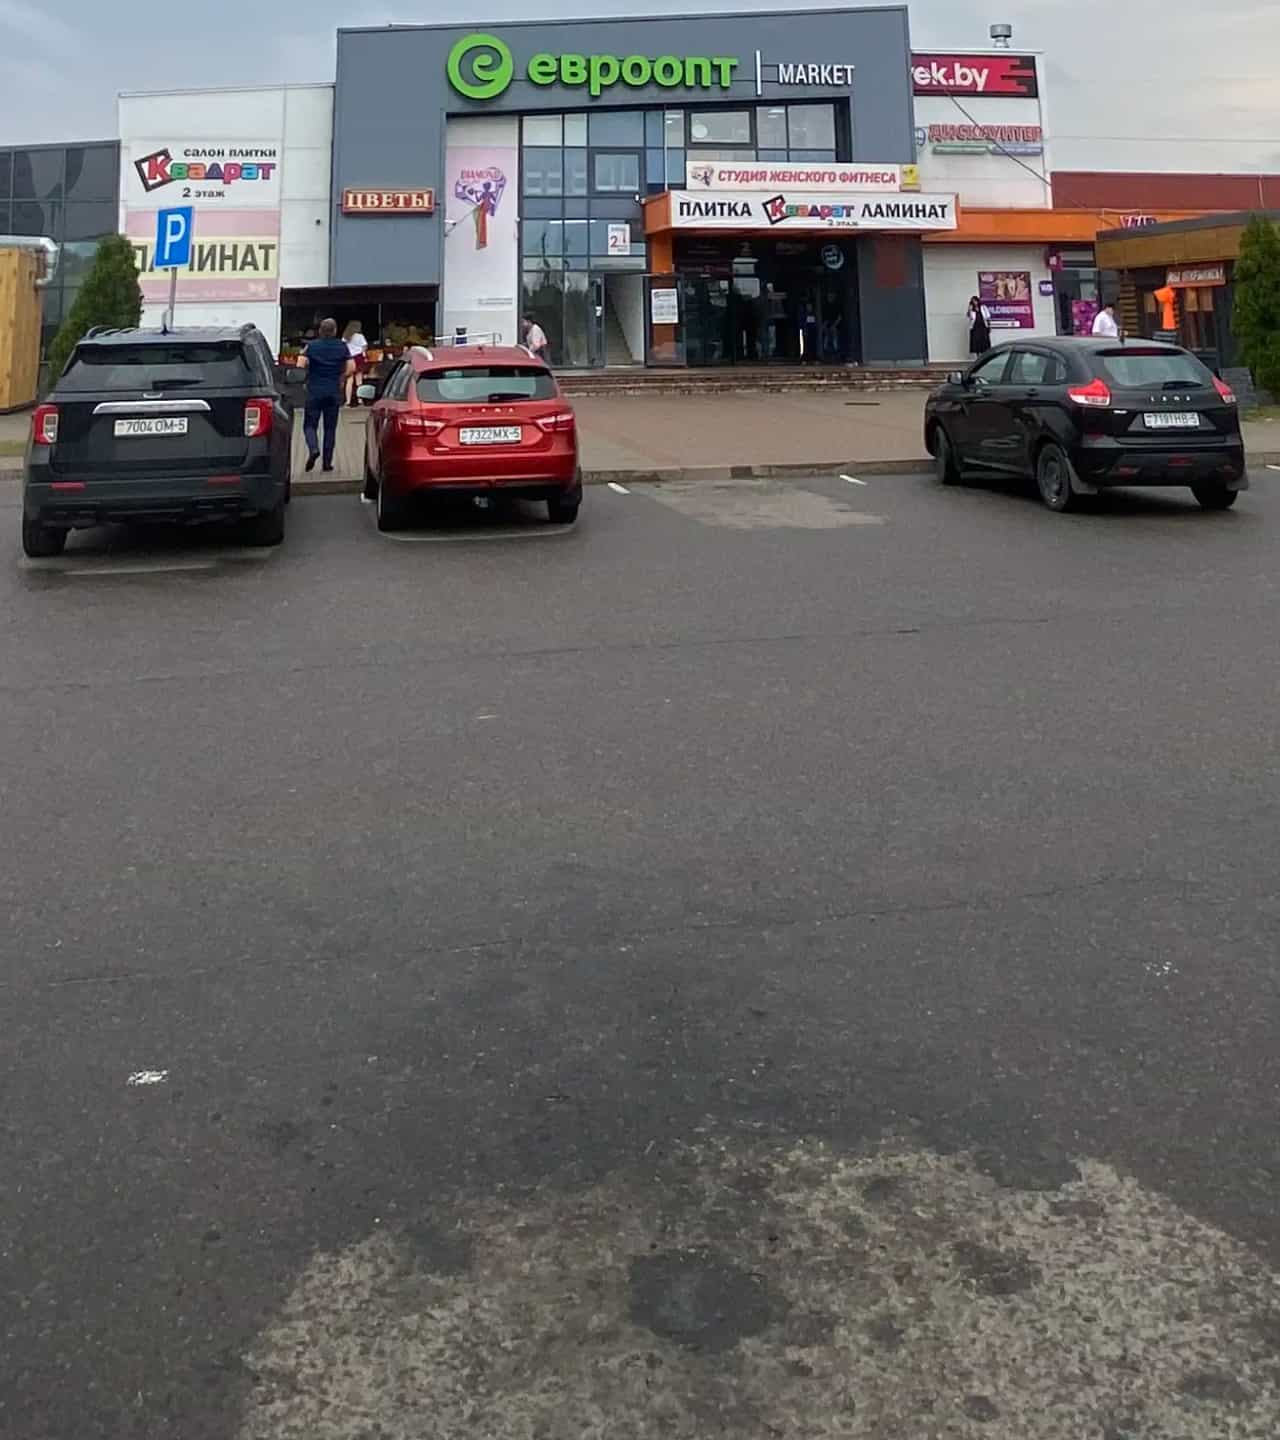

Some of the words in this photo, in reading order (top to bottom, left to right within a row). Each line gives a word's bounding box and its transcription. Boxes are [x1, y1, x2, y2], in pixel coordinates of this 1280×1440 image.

[528, 53, 738, 96] евроопт
[778, 63, 855, 85] MARKET
[911, 62, 989, 91] ek.by
[184, 148, 224, 157] салон
[229, 148, 276, 157] плитки
[146, 156, 276, 185] Квадрат
[718, 170, 767, 183] СТУДИЯ
[770, 170, 836, 183] ЖЕНСКОГО
[839, 171, 896, 184] ФИТНЕСА
[182, 187, 191, 198] 2
[194, 189, 225, 198] этаж
[347, 192, 431, 209] ЦВЕТЫ
[679, 202, 752, 218] ПЛИТКА
[861, 203, 948, 219] ЛАМИНАТ
[164, 214, 186, 260] P
[126, 421, 152, 433] 7004
